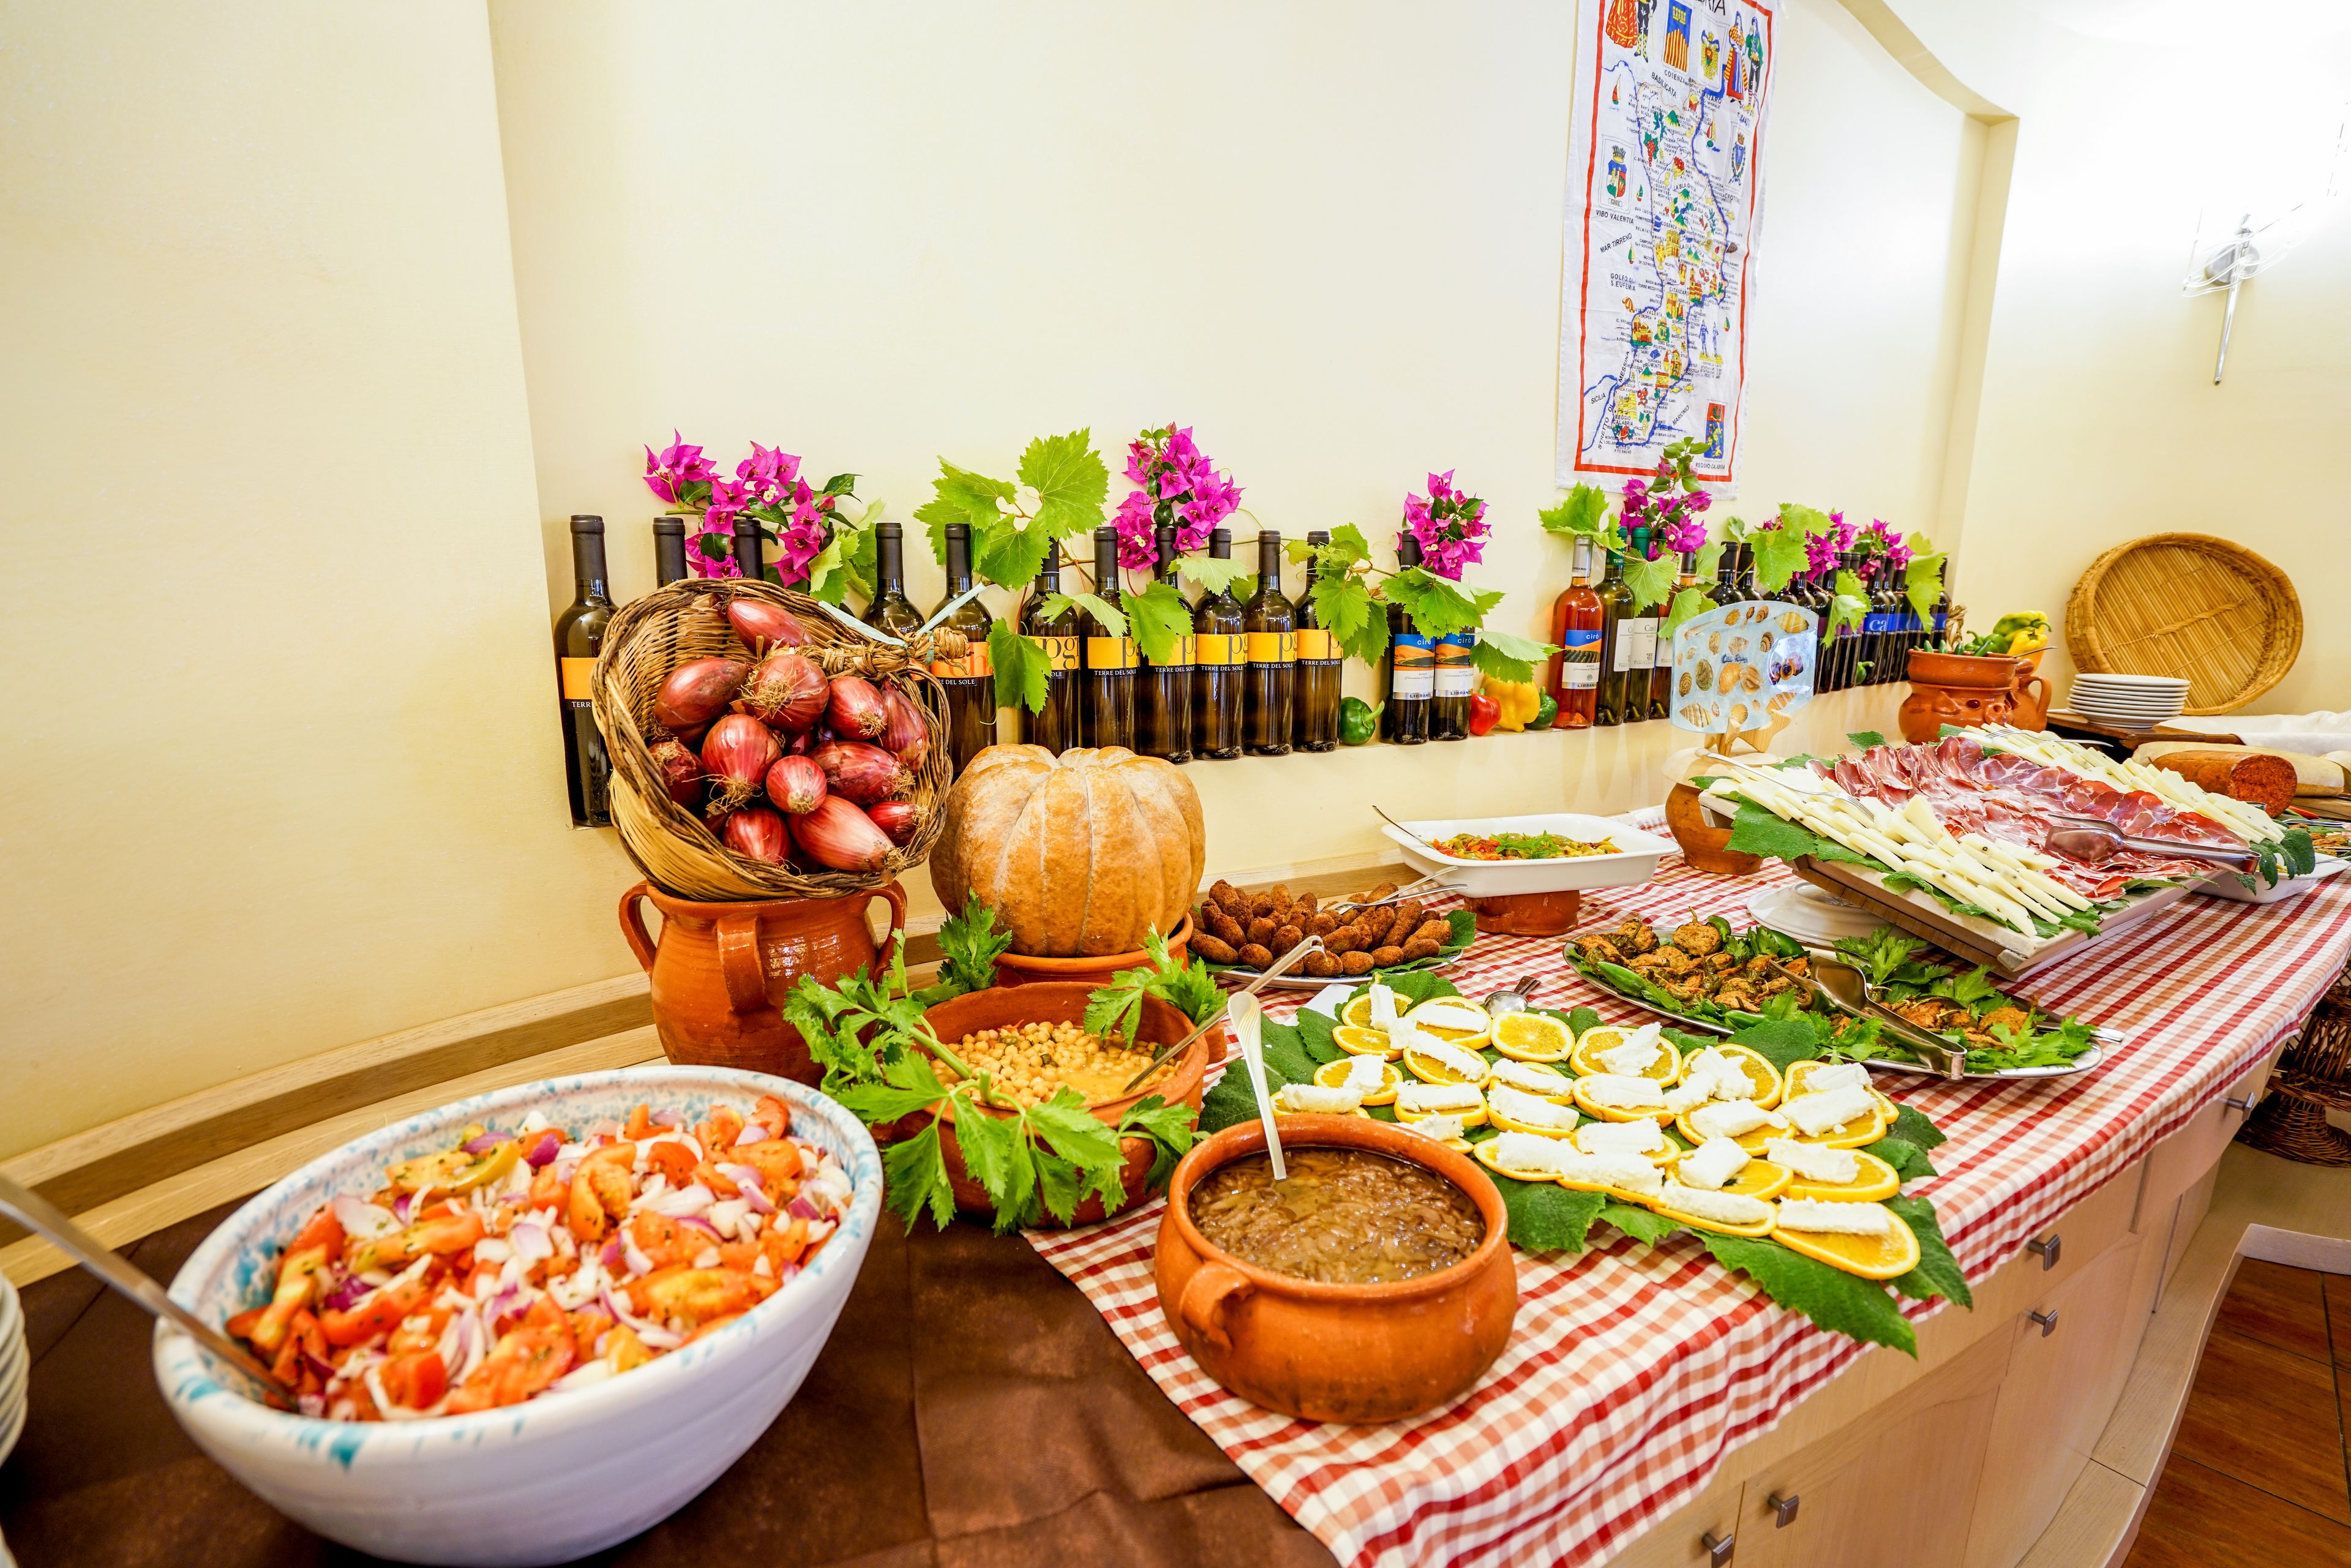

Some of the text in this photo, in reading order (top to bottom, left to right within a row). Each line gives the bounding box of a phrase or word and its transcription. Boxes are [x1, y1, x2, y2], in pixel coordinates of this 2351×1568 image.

[1664, 69, 1685, 84] COSENZA
[1651, 72, 1676, 98] BASILICATA
[1596, 209, 1634, 224] VIBO VALENTIA
[1600, 233, 1632, 253] MAR TIRRENO
[1611, 280, 1636, 291] S.EUFEMIA
[1591, 392, 1606, 404] SICILIA
[1597, 417, 1610, 449] STRETTO
[1608, 404, 1613, 413] DI
[1618, 351, 1630, 383] MESSINA
